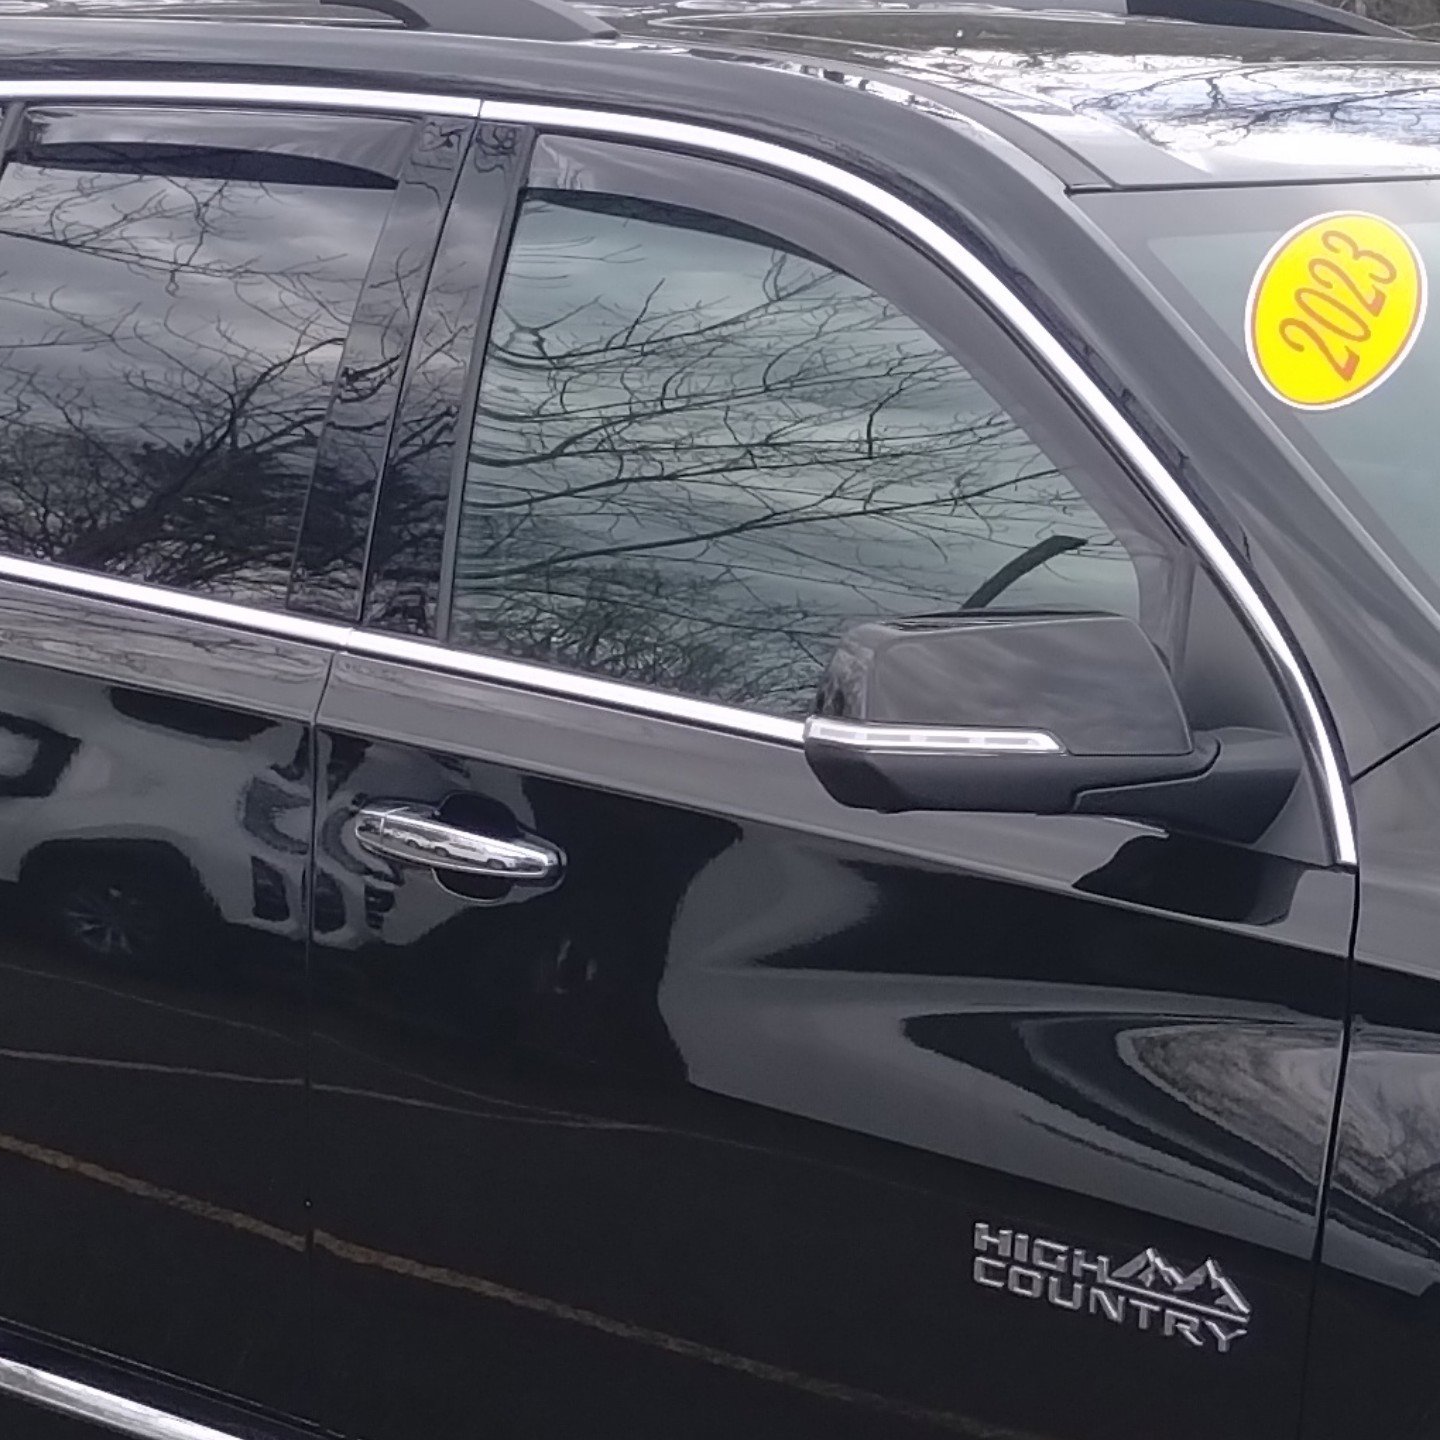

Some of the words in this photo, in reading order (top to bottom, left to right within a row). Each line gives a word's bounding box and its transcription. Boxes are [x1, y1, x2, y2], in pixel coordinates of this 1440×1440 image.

[1279, 230, 1397, 382] 2023
[973, 1221, 1110, 1283] HIGH
[973, 1256, 1248, 1352] COUNTRY
